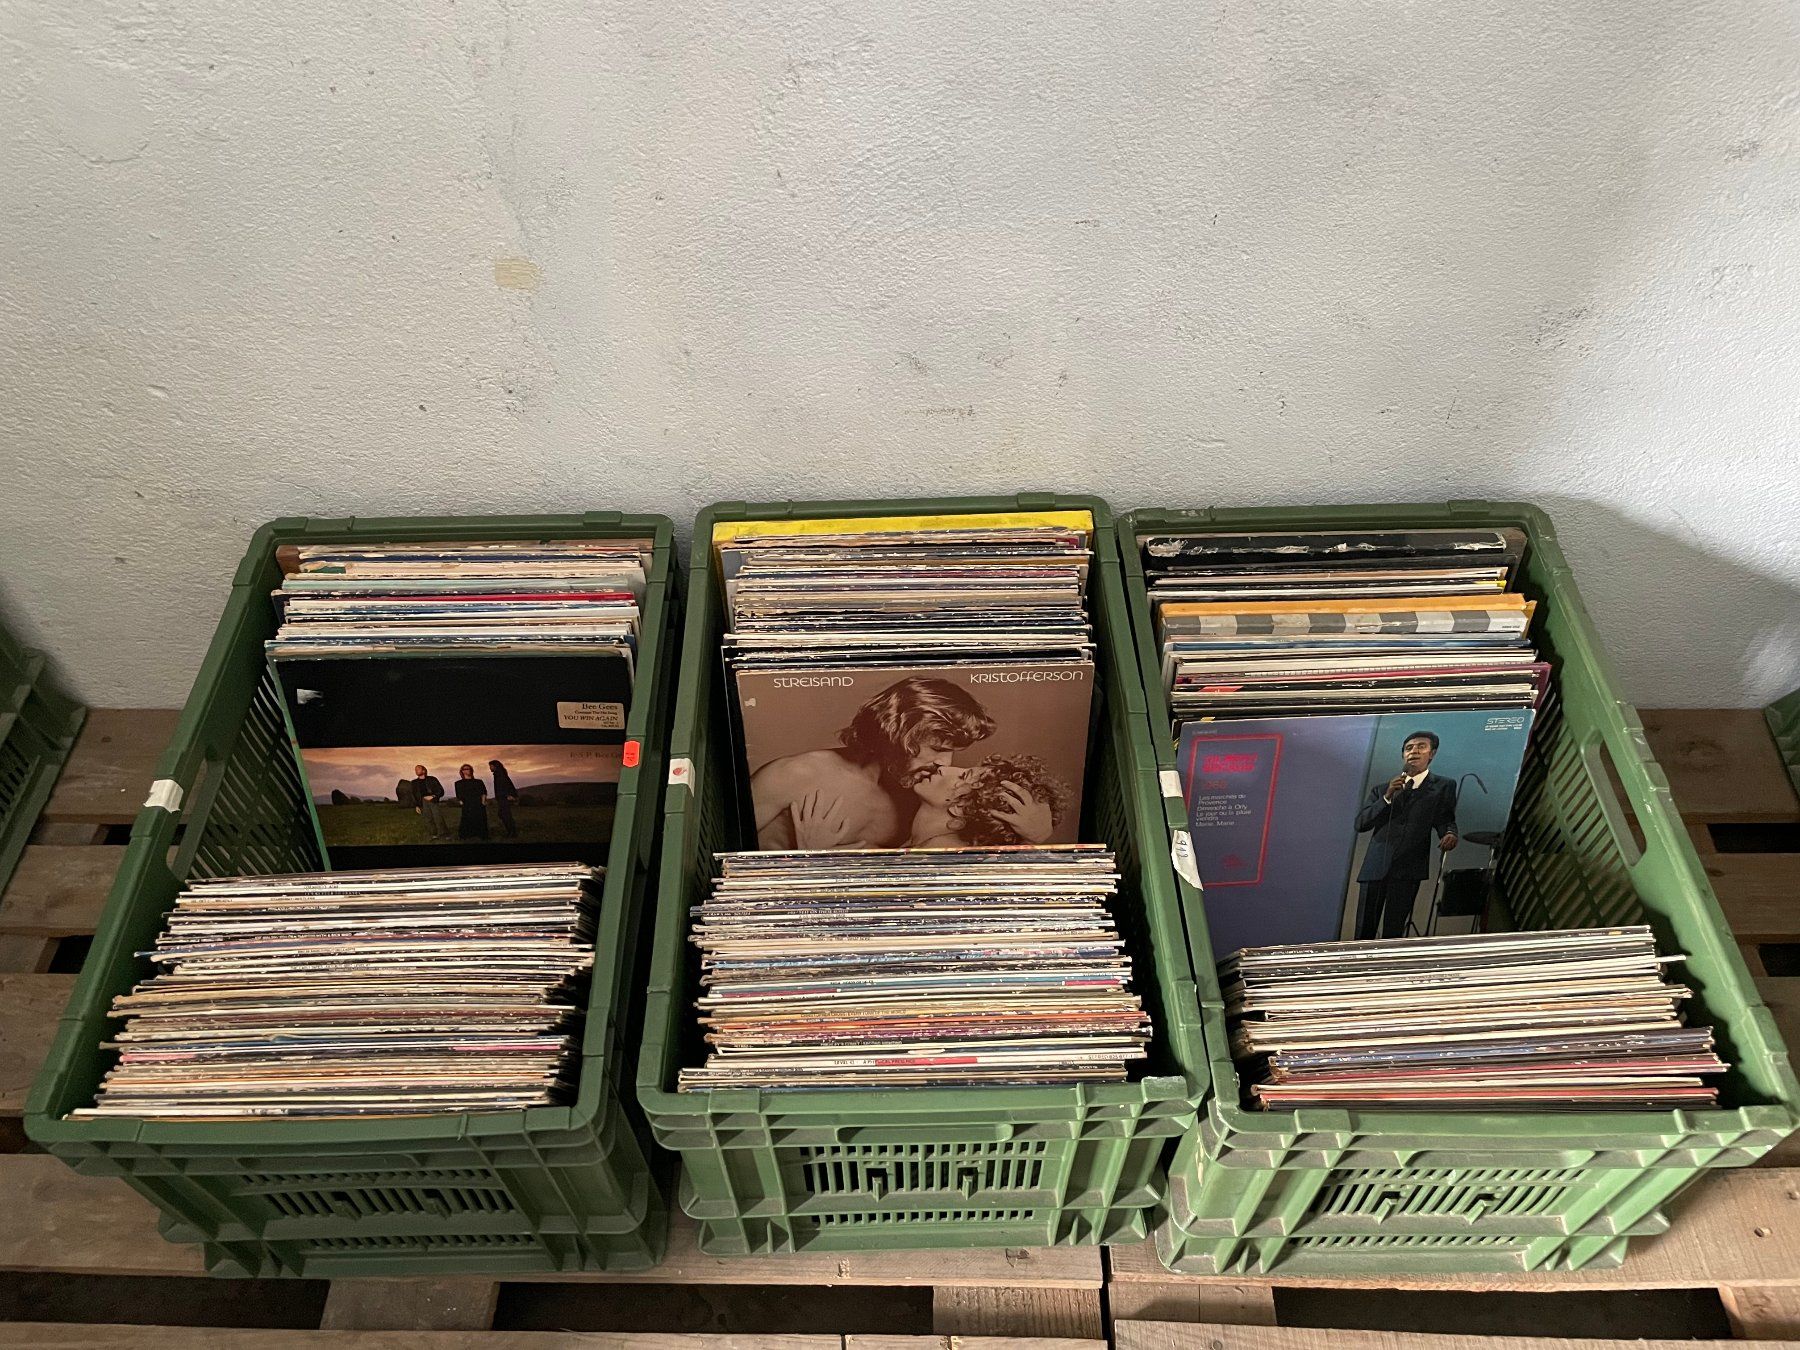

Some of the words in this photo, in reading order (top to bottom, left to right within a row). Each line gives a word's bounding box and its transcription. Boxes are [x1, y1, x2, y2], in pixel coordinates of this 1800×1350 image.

[773, 676, 854, 688] STREISAND
[970, 670, 1084, 683] KRISTOFFERSON
[1486, 716, 1525, 725] STEREO
